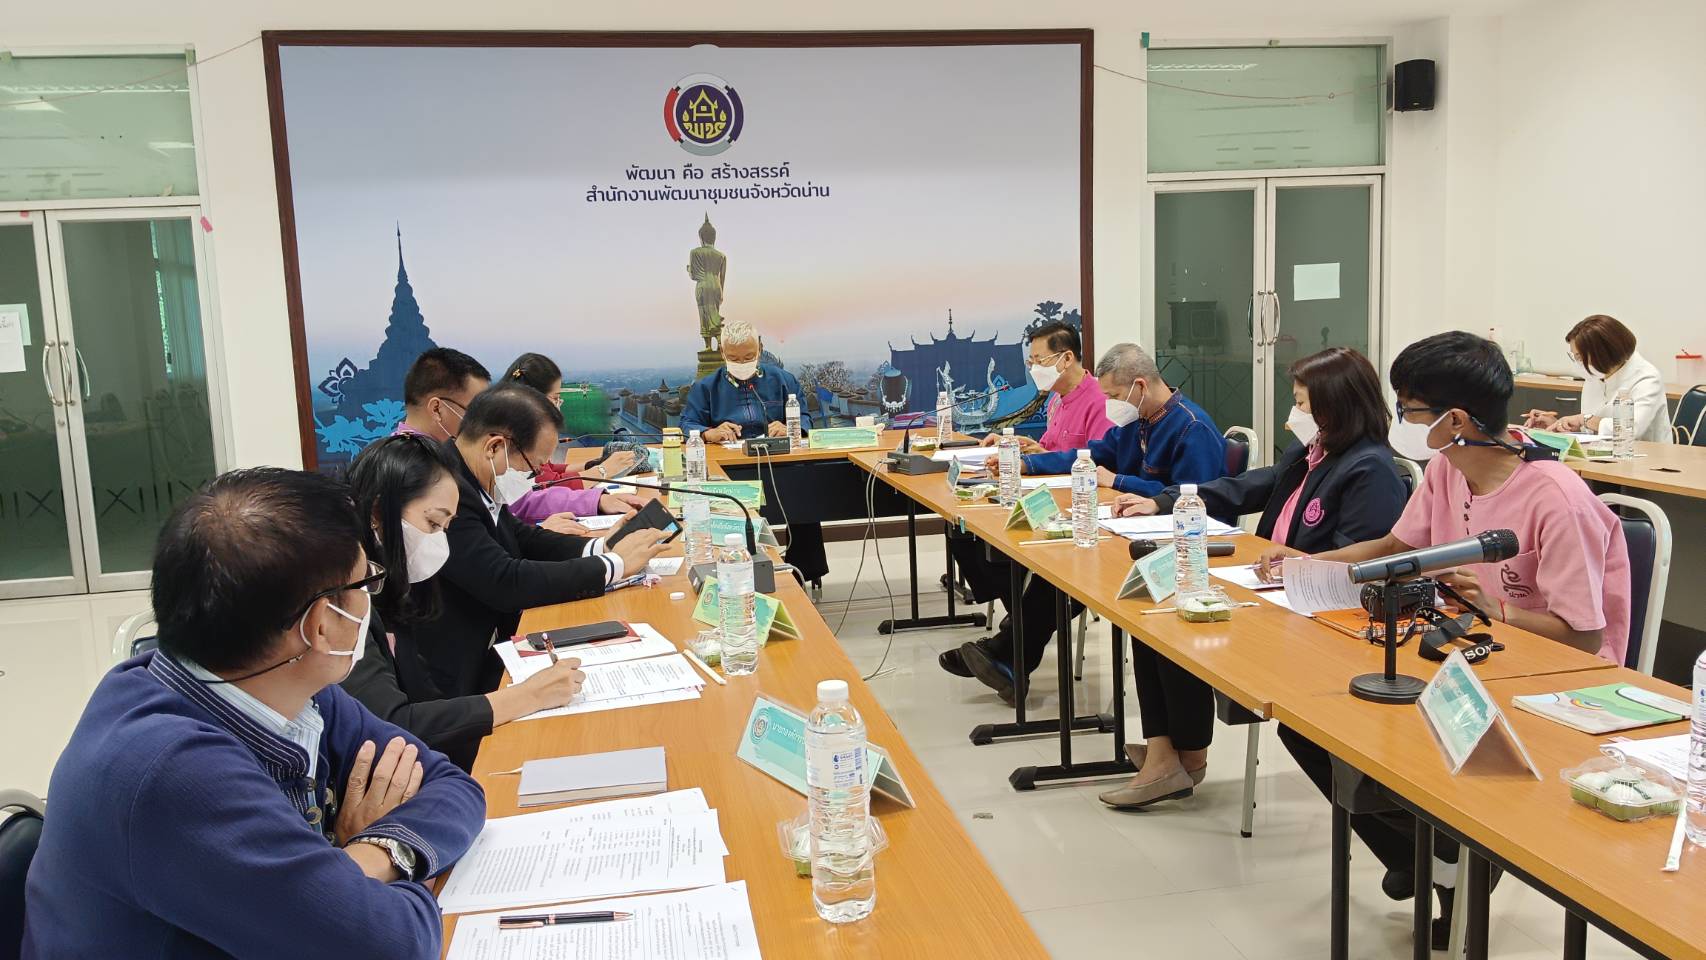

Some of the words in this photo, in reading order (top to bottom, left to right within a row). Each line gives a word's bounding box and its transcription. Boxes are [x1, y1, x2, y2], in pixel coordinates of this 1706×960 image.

[625, 164, 675, 180] พัฒนา
[683, 163, 704, 179] คือ
[711, 161, 790, 179] สร้างสรรค์
[586, 180, 830, 205] สำนักงานพัฒนาชุมชนจังหวัดน่าน
[1464, 643, 1494, 660] SON
